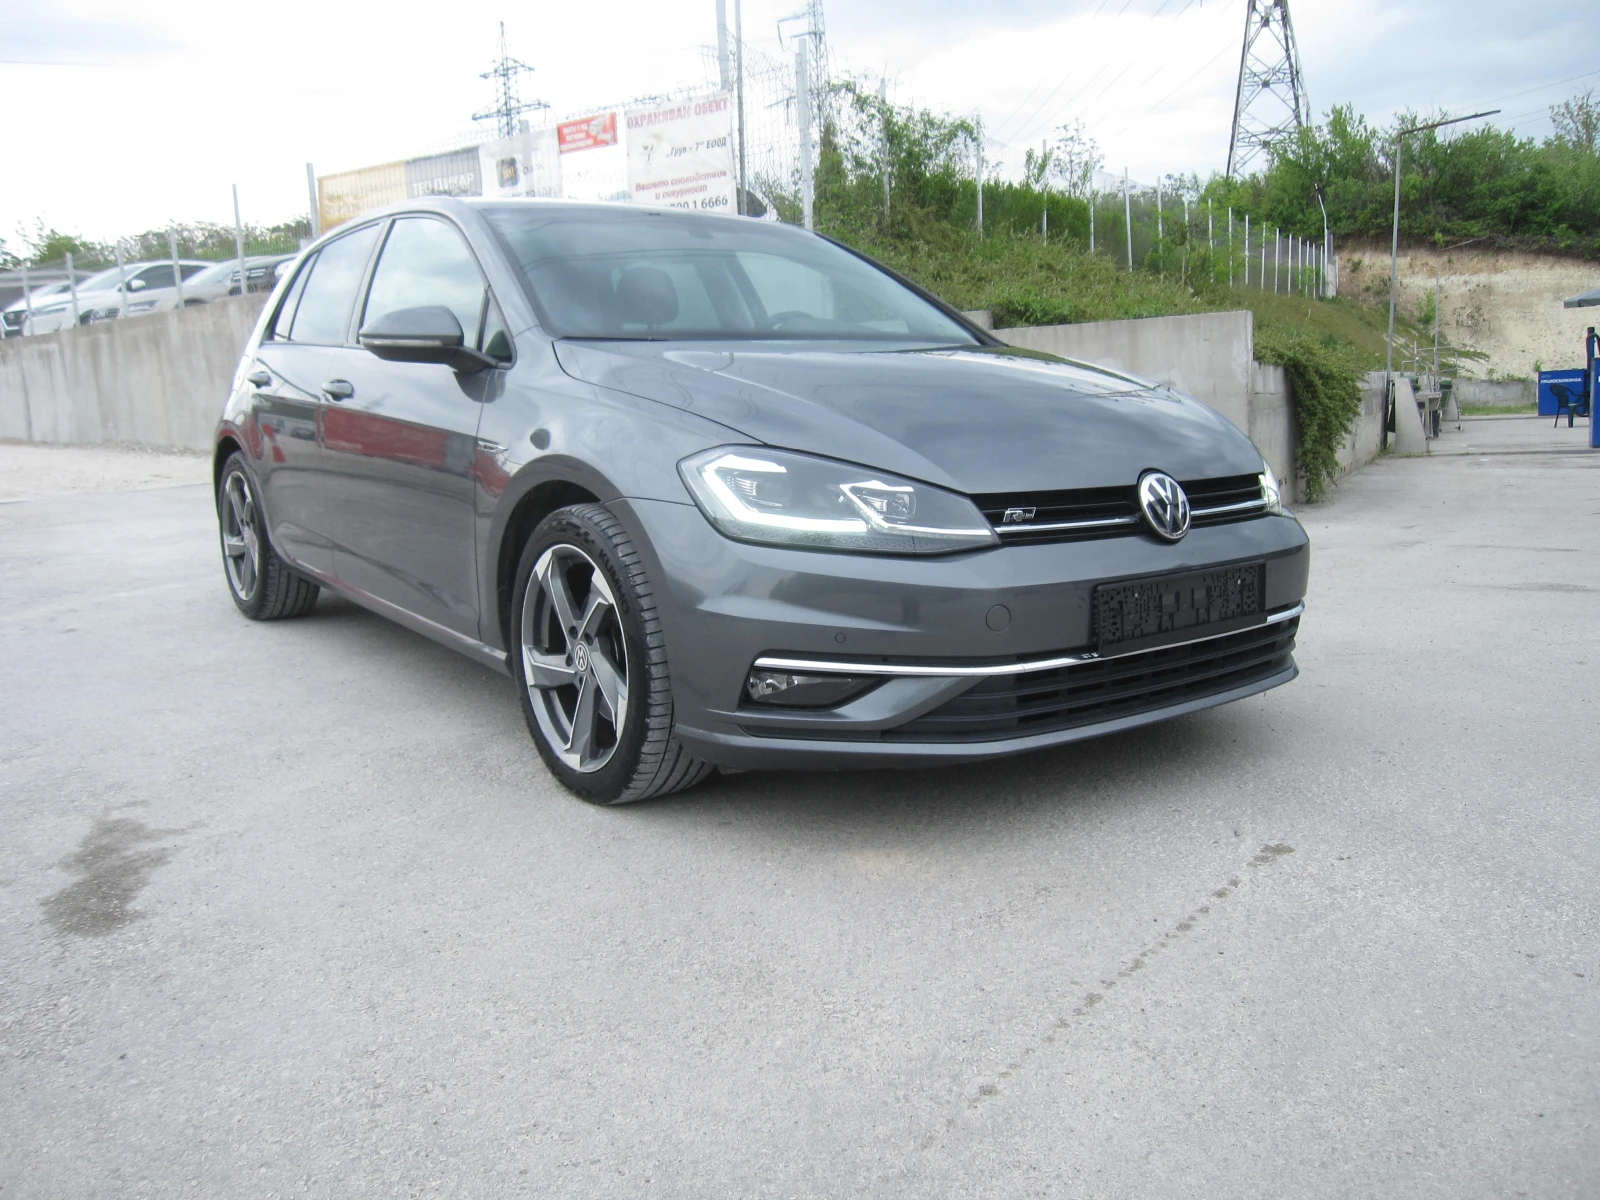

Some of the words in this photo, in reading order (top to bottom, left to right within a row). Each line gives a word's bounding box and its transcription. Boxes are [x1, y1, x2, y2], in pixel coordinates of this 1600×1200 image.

[627, 105, 691, 129] ОХРАНЯВАН
[694, 97, 729, 117] ОБЕКТ
[706, 136, 727, 149] ЕООД
[635, 179, 669, 192] Вашето
[670, 169, 728, 186] спокойствие
[655, 192, 661, 200] и
[662, 184, 708, 199] сигурност
[701, 195, 729, 209] 6666
